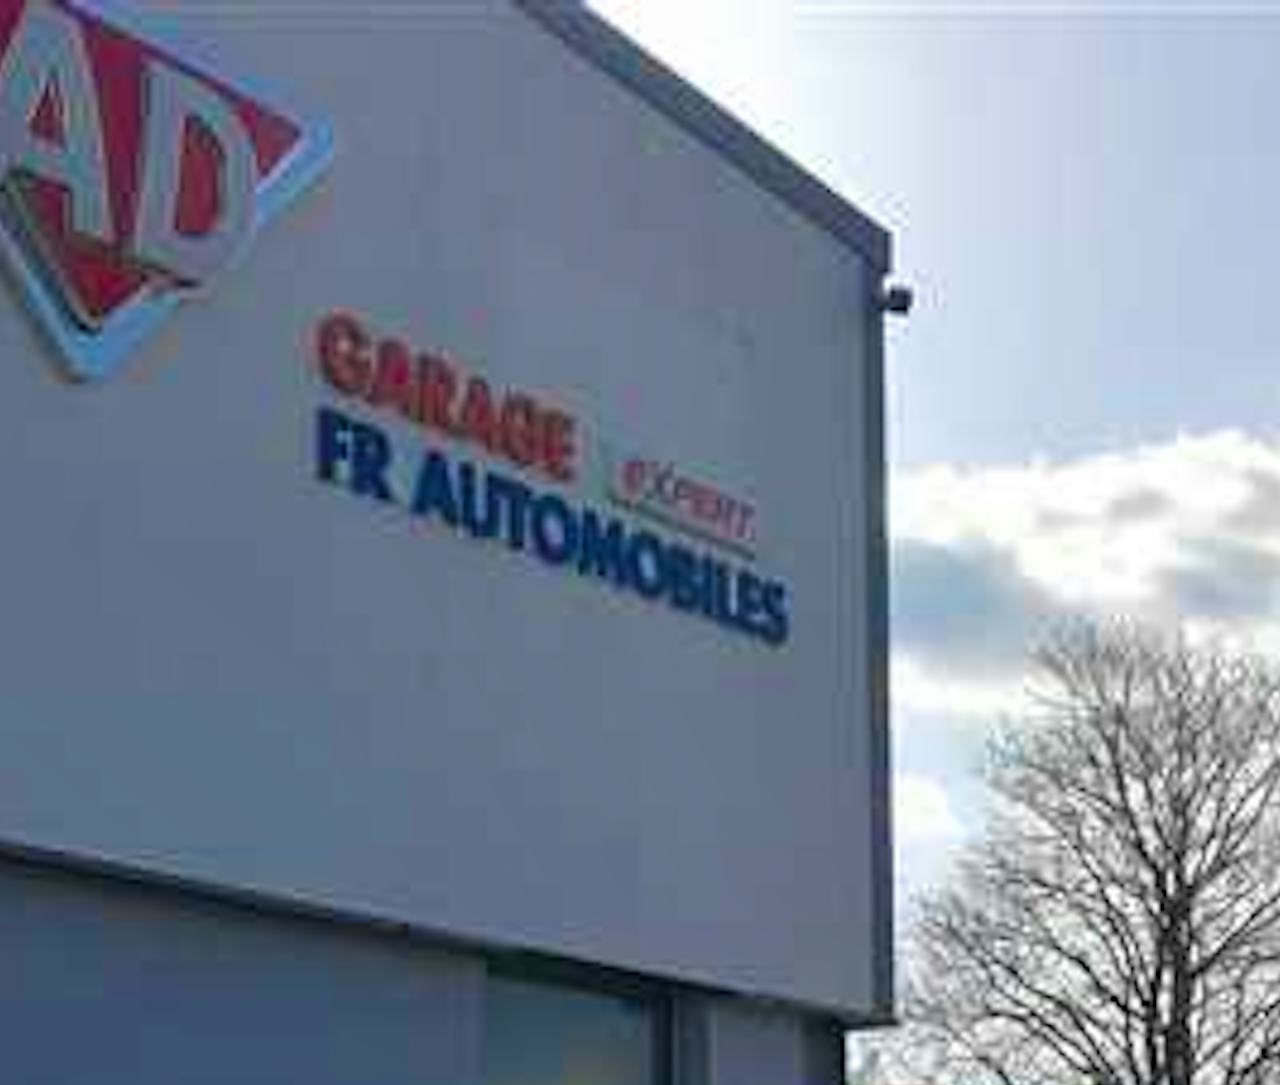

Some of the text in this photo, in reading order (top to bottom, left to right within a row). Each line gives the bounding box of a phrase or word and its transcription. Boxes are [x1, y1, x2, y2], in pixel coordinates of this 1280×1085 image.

[317, 314, 580, 482] GARAGE
[316, 407, 790, 648] FR AUTOMOBILES
